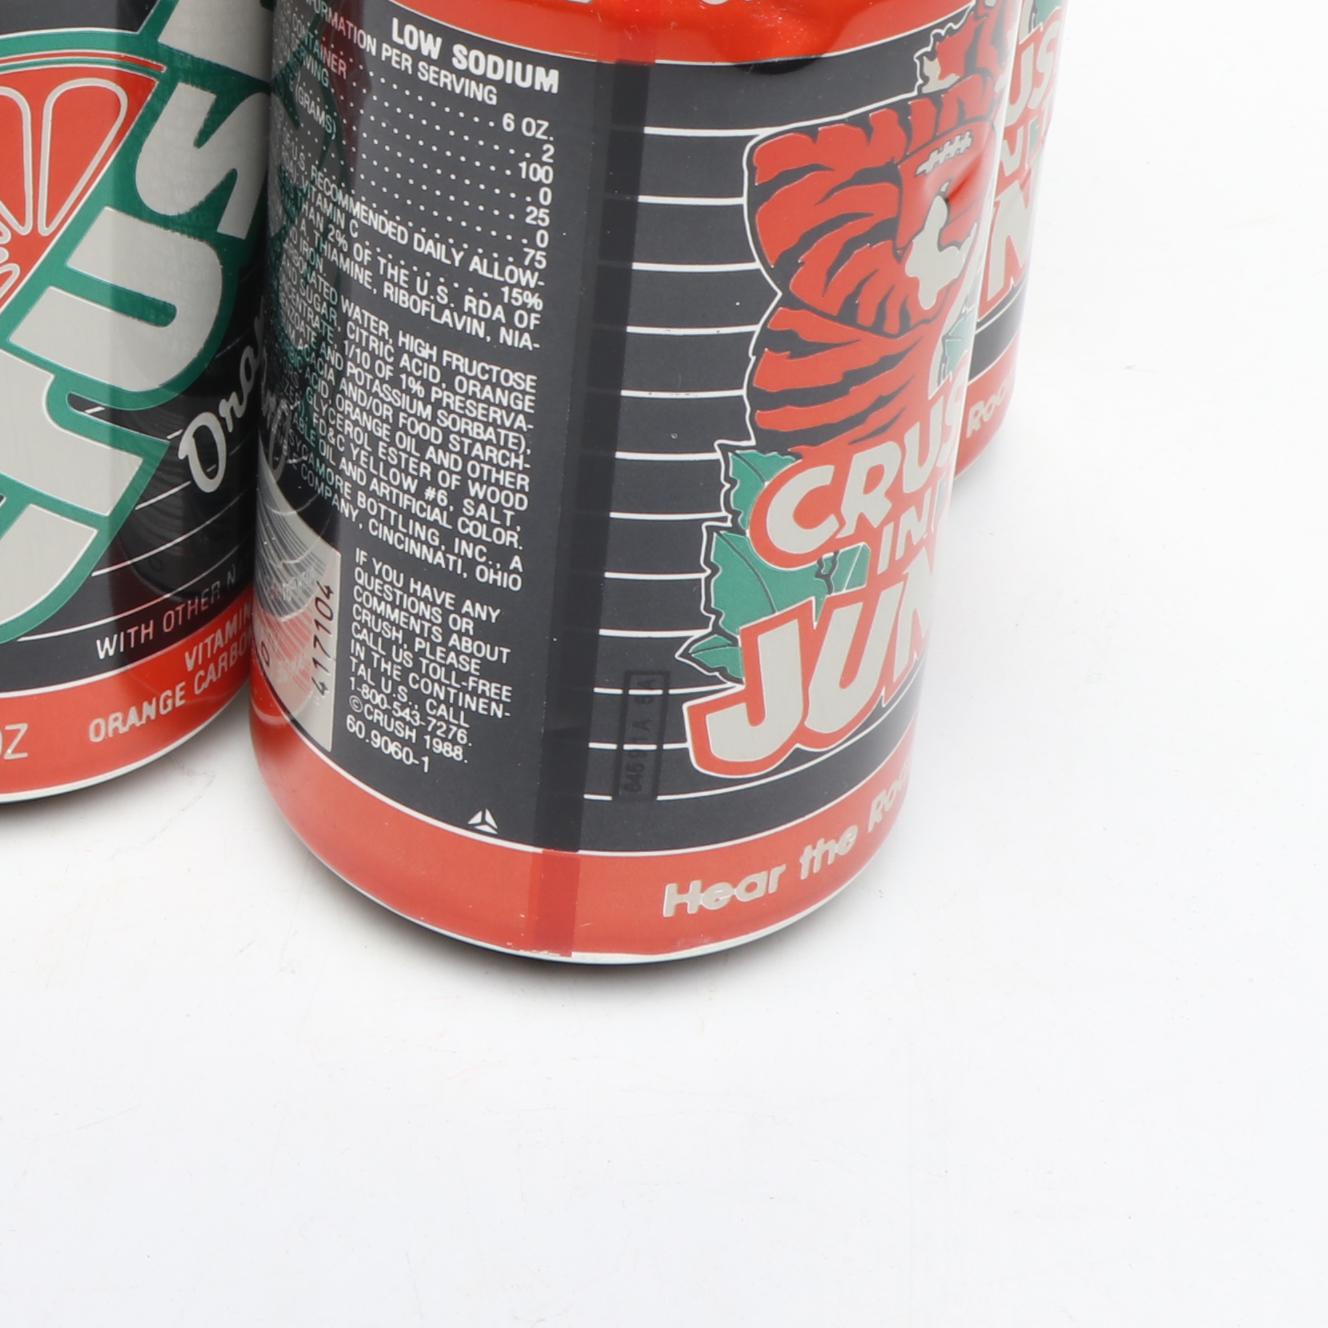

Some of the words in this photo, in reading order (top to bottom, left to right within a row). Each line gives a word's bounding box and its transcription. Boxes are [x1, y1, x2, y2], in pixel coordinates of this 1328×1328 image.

[381, 42, 413, 75] PER
[418, 61, 498, 106] SERVING
[391, 17, 443, 60] LOW
[452, 43, 560, 94] SODIUM
[502, 112, 515, 133] 6
[521, 117, 555, 141] OZ.
[541, 144, 555, 163] 2
[518, 161, 554, 185] 100
[539, 187, 552, 206] 0
[311, 164, 408, 245] RECOMMENDED
[413, 234, 465, 267] DAILY
[469, 256, 545, 289] ALLOW-
[525, 207, 550, 227] 25
[535, 229, 549, 249] 0
[328, 224, 349, 252] 2%
[353, 243, 372, 265] OF
[377, 255, 409, 288] THE
[464, 295, 506, 322] RDA
[514, 311, 541, 331] OF
[522, 247, 548, 270] 75
[501, 287, 544, 311] 15%
[346, 322, 395, 363] CITRIC
[454, 374, 535, 414] ORANGE
[398, 330, 438, 362] HIGH
[442, 352, 538, 394] FRUCTOSE
[499, 325, 541, 352] NIA-
[320, 340, 344, 370] AND
[346, 362, 432, 421] POTASSIUM
[375, 359, 394, 382] OF
[399, 374, 425, 398] 1%
[430, 387, 534, 432] PRESERVA-
[306, 387, 372, 452] GLYCEROL
[378, 441, 431, 482] ESTER
[437, 465, 462, 491] OF
[467, 480, 529, 511] WOOD
[312, 414, 345, 453] FD&C
[350, 443, 419, 496] YELLOW
[335, 393, 390, 443] ORANGE
[395, 429, 420, 458] OIL
[425, 445, 463, 473] AND
[467, 459, 530, 490] OTHER
[339, 380, 394, 424] AND/OR
[399, 414, 443, 445] FOOD
[448, 437, 531, 470] STARCH-
[319, 439, 336, 466] OIL
[339, 456, 367, 487] AND
[369, 478, 453, 532] ARTIFICIAL
[457, 520, 524, 551] COLOR.
[765, 394, 962, 556] CRUS
[509, 553, 523, 573] A
[877, 493, 928, 572] IN
[354, 567, 442, 625] QUESTIONS
[448, 613, 474, 635] OR
[355, 547, 369, 567] IF
[372, 556, 405, 587] YOU
[410, 578, 456, 610] HAVE
[462, 601, 503, 623] ANY
[475, 567, 523, 592] OHIO
[96, 619, 154, 660] WITH
[163, 582, 221, 633] OTHER
[353, 586, 442, 643] COMMENTS
[448, 632, 511, 664] ABOUT
[350, 659, 376, 685] TAL
[425, 697, 470, 728] CALL
[351, 641, 364, 662] IN
[370, 654, 402, 683] THE
[408, 669, 511, 718] CONTINEN-
[352, 623, 386, 656] CALL
[392, 645, 414, 667] US
[419, 660, 512, 703] TOLL-FREE
[414, 640, 481, 676] PLEASE
[88, 681, 186, 743] ORANGE
[346, 715, 430, 773] 60.9060-1
[423, 734, 469, 765] 1988.
[662, 864, 786, 919] Hear
[800, 824, 857, 880] the
